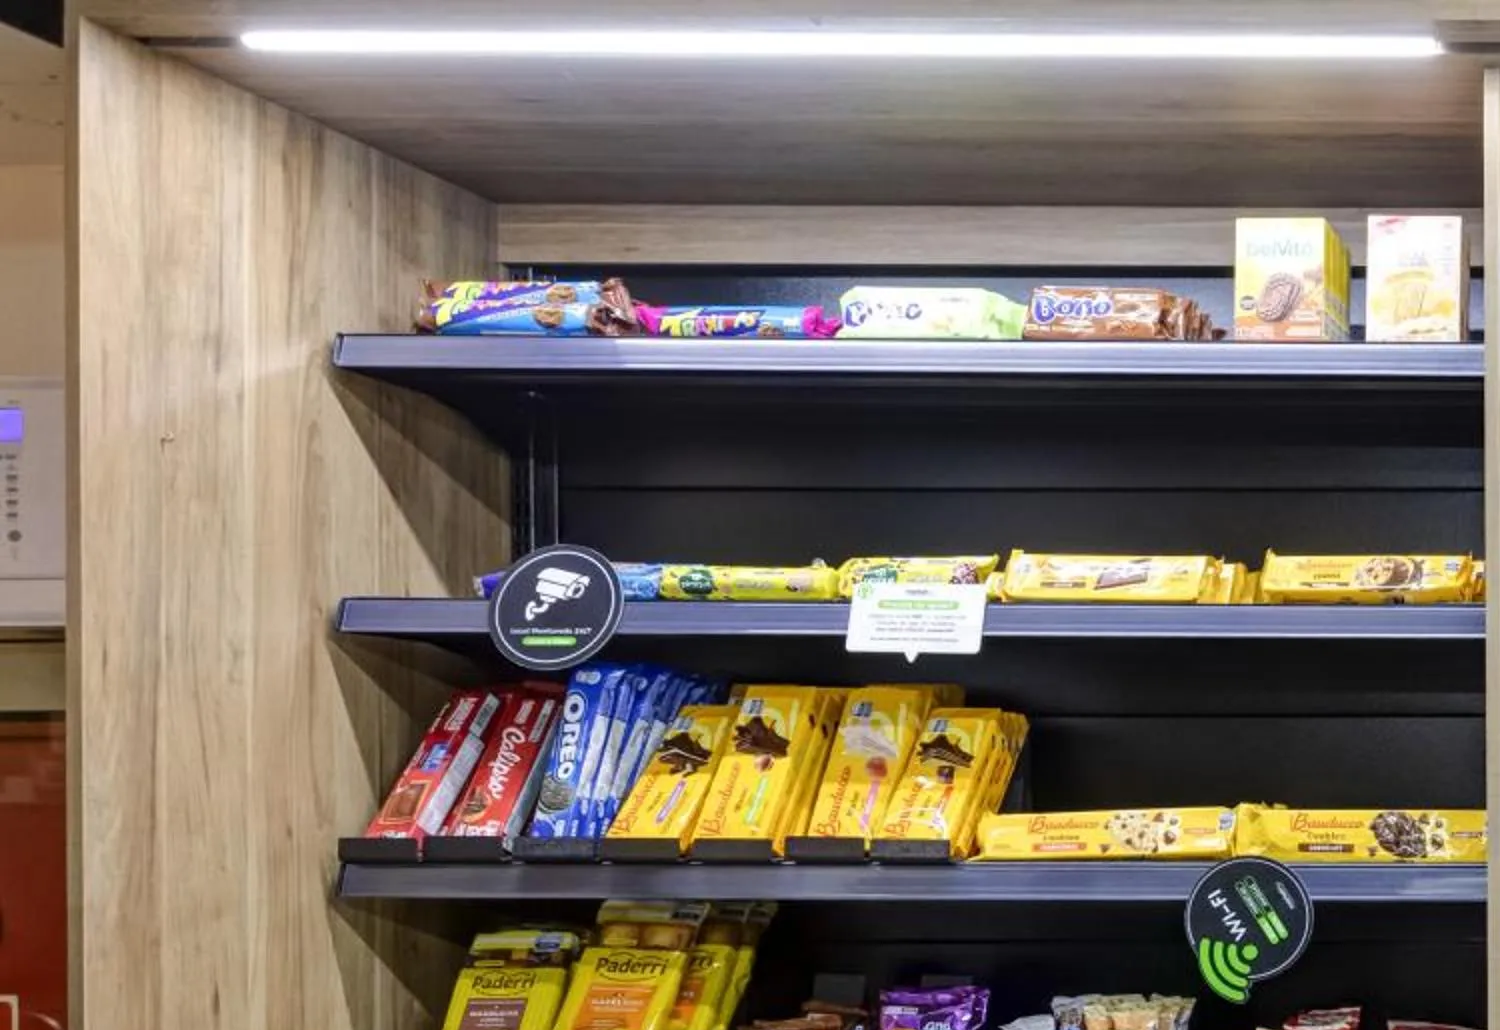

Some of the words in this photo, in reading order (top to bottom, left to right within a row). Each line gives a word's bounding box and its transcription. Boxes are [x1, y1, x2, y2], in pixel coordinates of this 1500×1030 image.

[558, 693, 586, 779] OREO
[486, 727, 526, 800] Calipso
[1290, 813, 1365, 833] Bauducco
[1207, 888, 1248, 942] WI-FI
[472, 970, 538, 992] Paderri
[595, 955, 671, 977] Paderri
